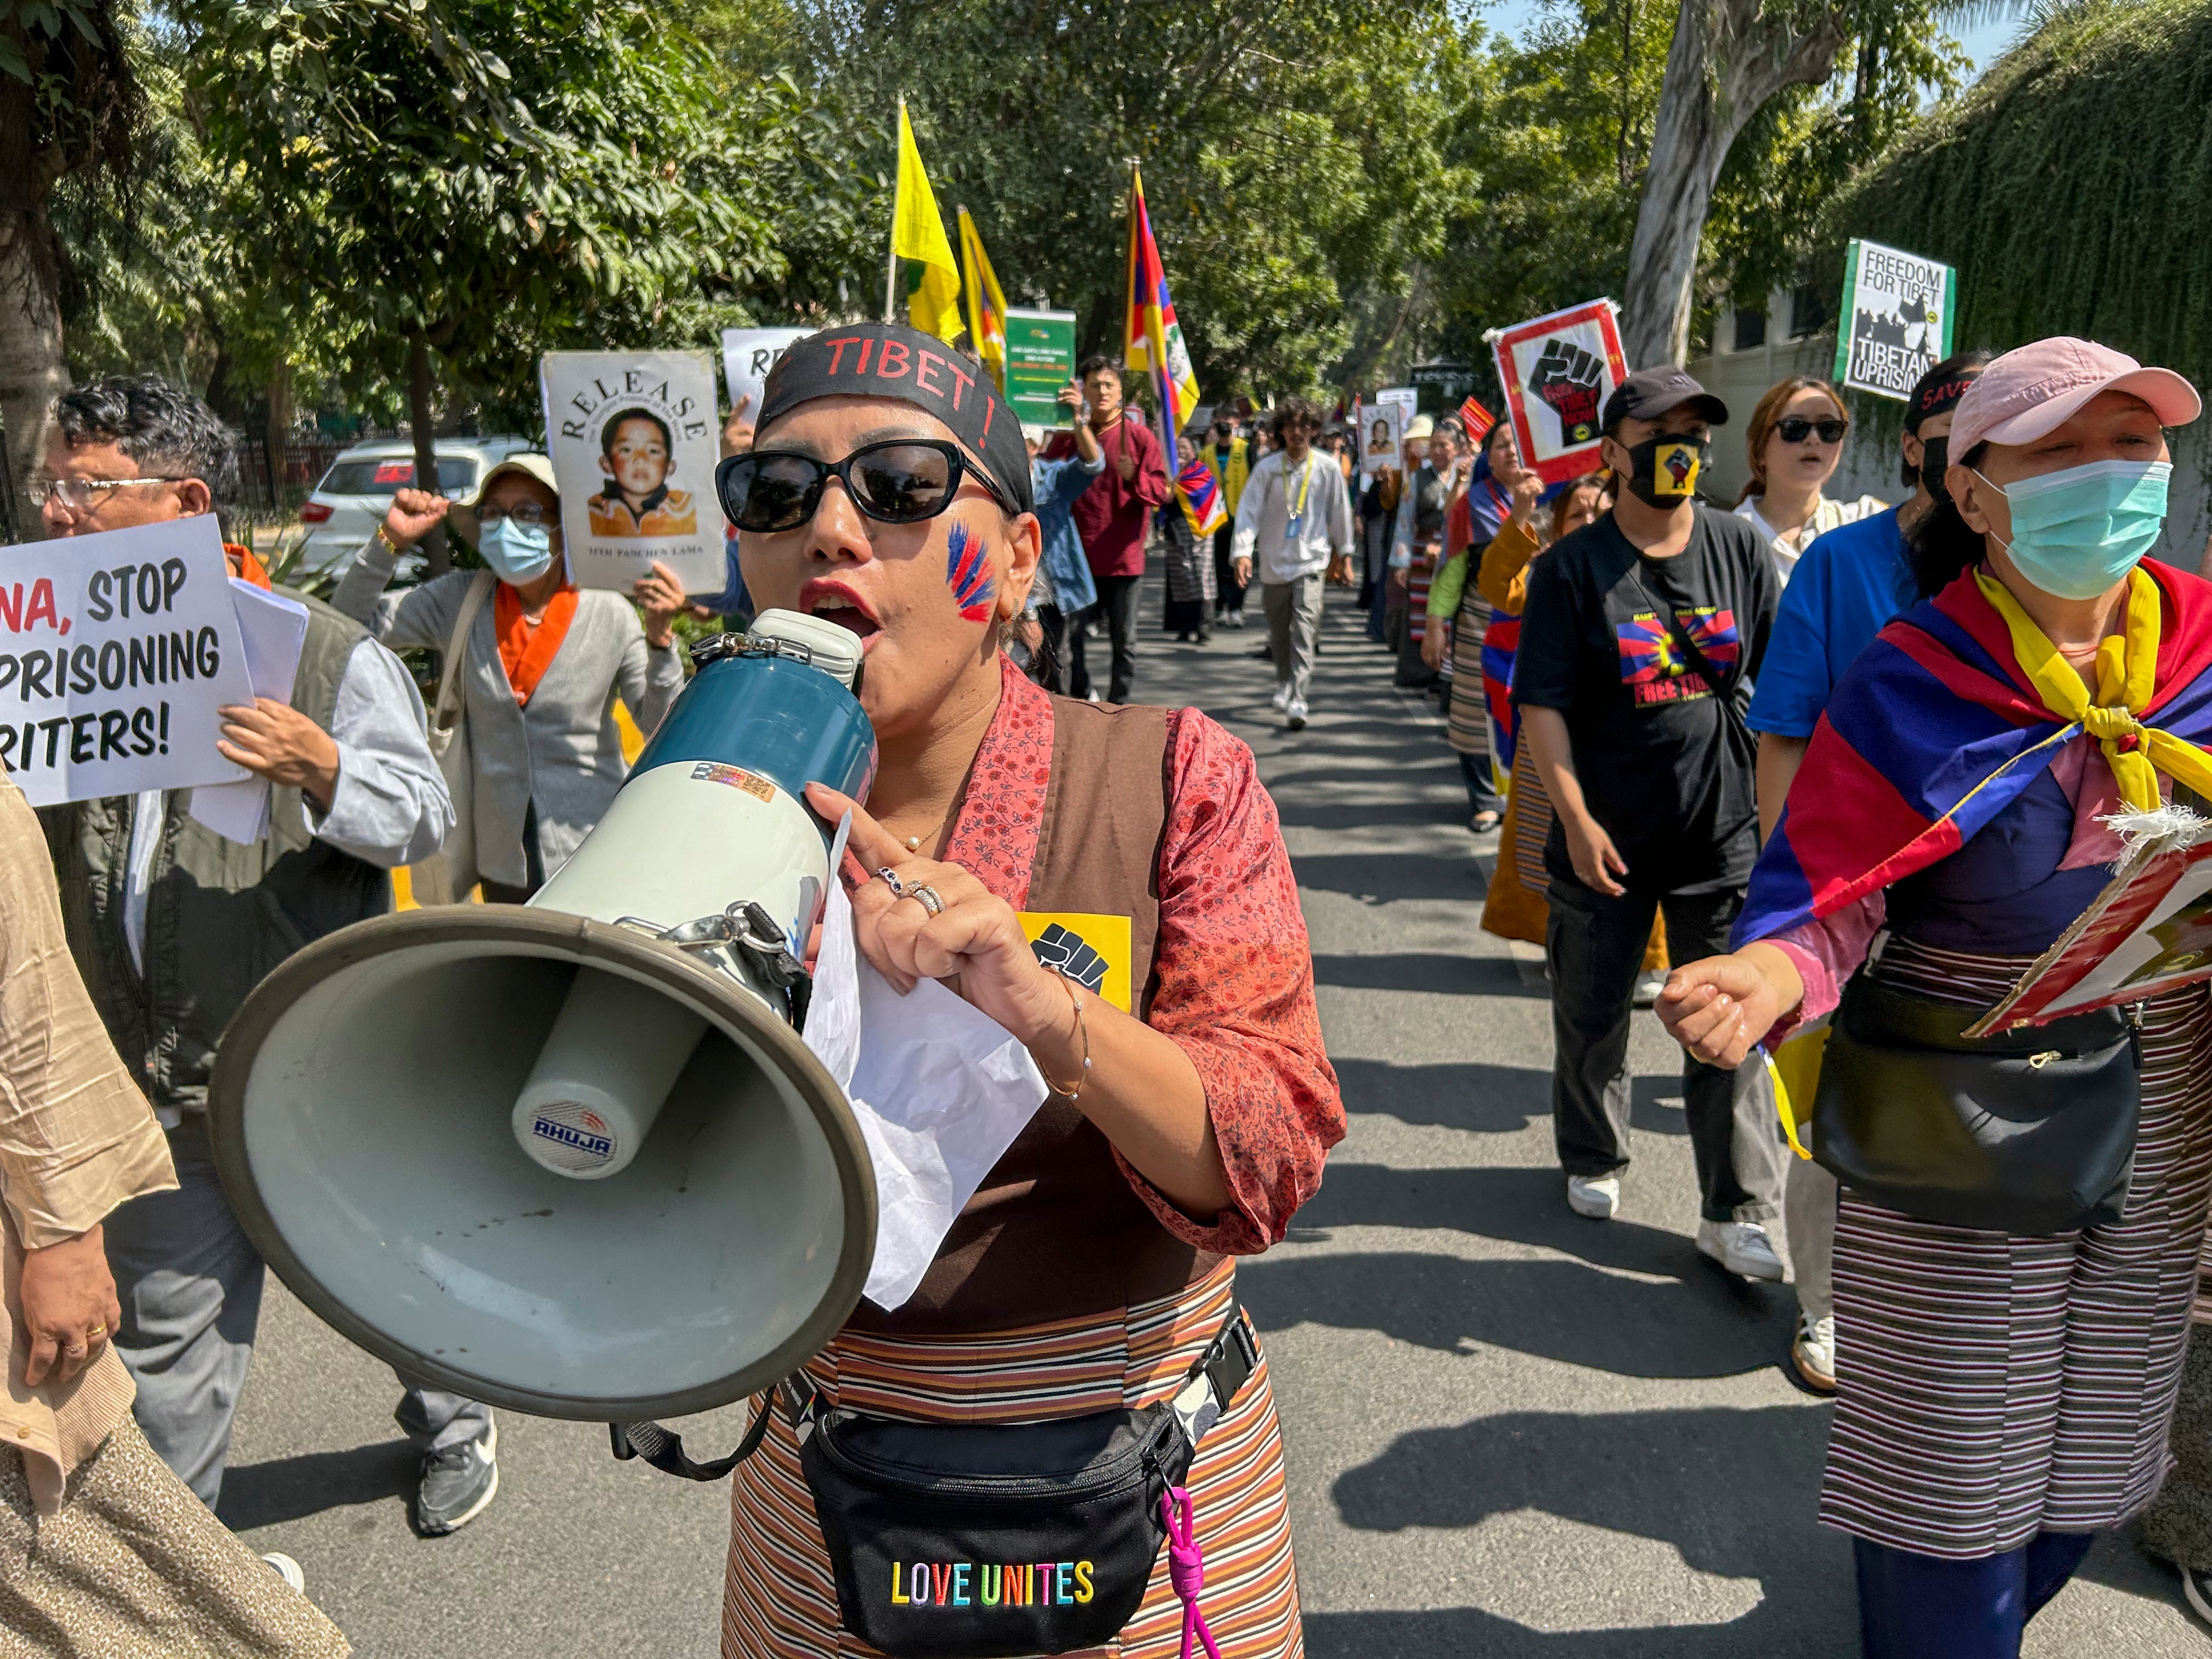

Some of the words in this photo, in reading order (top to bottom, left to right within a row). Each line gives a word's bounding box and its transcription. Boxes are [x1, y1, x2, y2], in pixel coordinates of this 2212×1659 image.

[1864, 270, 1895, 295] FOR
[1899, 279, 1940, 307] TIBET
[1866, 250, 1941, 289] FREEDOM
[1854, 358, 1921, 393] UPRISIN
[1857, 337, 1929, 377] TIBETAN
[561, 370, 708, 441] RELEASE
[88, 557, 188, 622] STOP
[534, 1120, 611, 1153] AHUJA
[891, 1561, 972, 1606] LOVE
[981, 1560, 1094, 1606] UNITES
